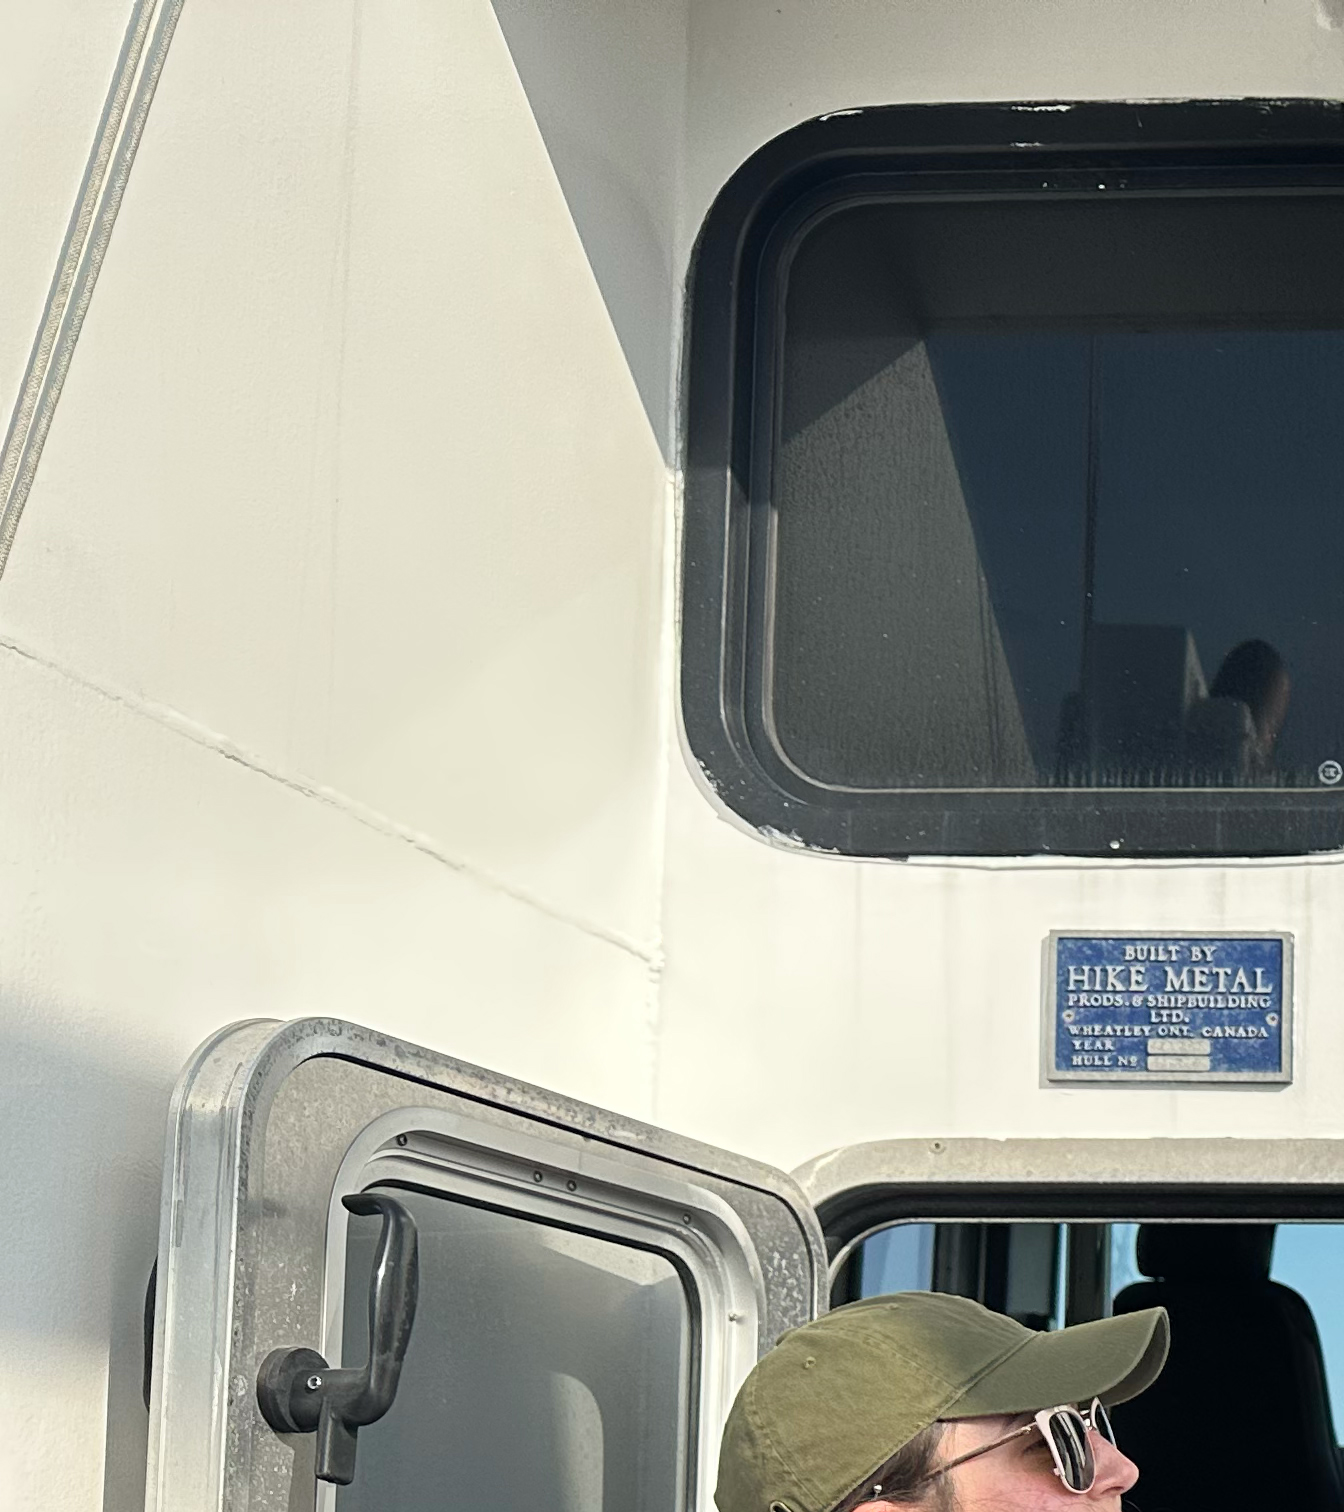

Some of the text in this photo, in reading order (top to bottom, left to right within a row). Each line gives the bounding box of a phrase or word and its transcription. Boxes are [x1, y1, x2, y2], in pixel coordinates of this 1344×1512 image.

[1123, 945, 1218, 963] BUILT BY
[1067, 964, 1274, 994] HIKE METAL
[1067, 993, 1130, 1008] PRODS.
[1146, 994, 1272, 1009] SHIPBUILDING
[1150, 1009, 1190, 1023] LTD.
[1068, 1024, 1152, 1037] WHEATLEY
[1201, 1026, 1270, 1038] CANADA
[1071, 1039, 1115, 1051] YEAR
[1072, 1055, 1113, 1067] HULL
